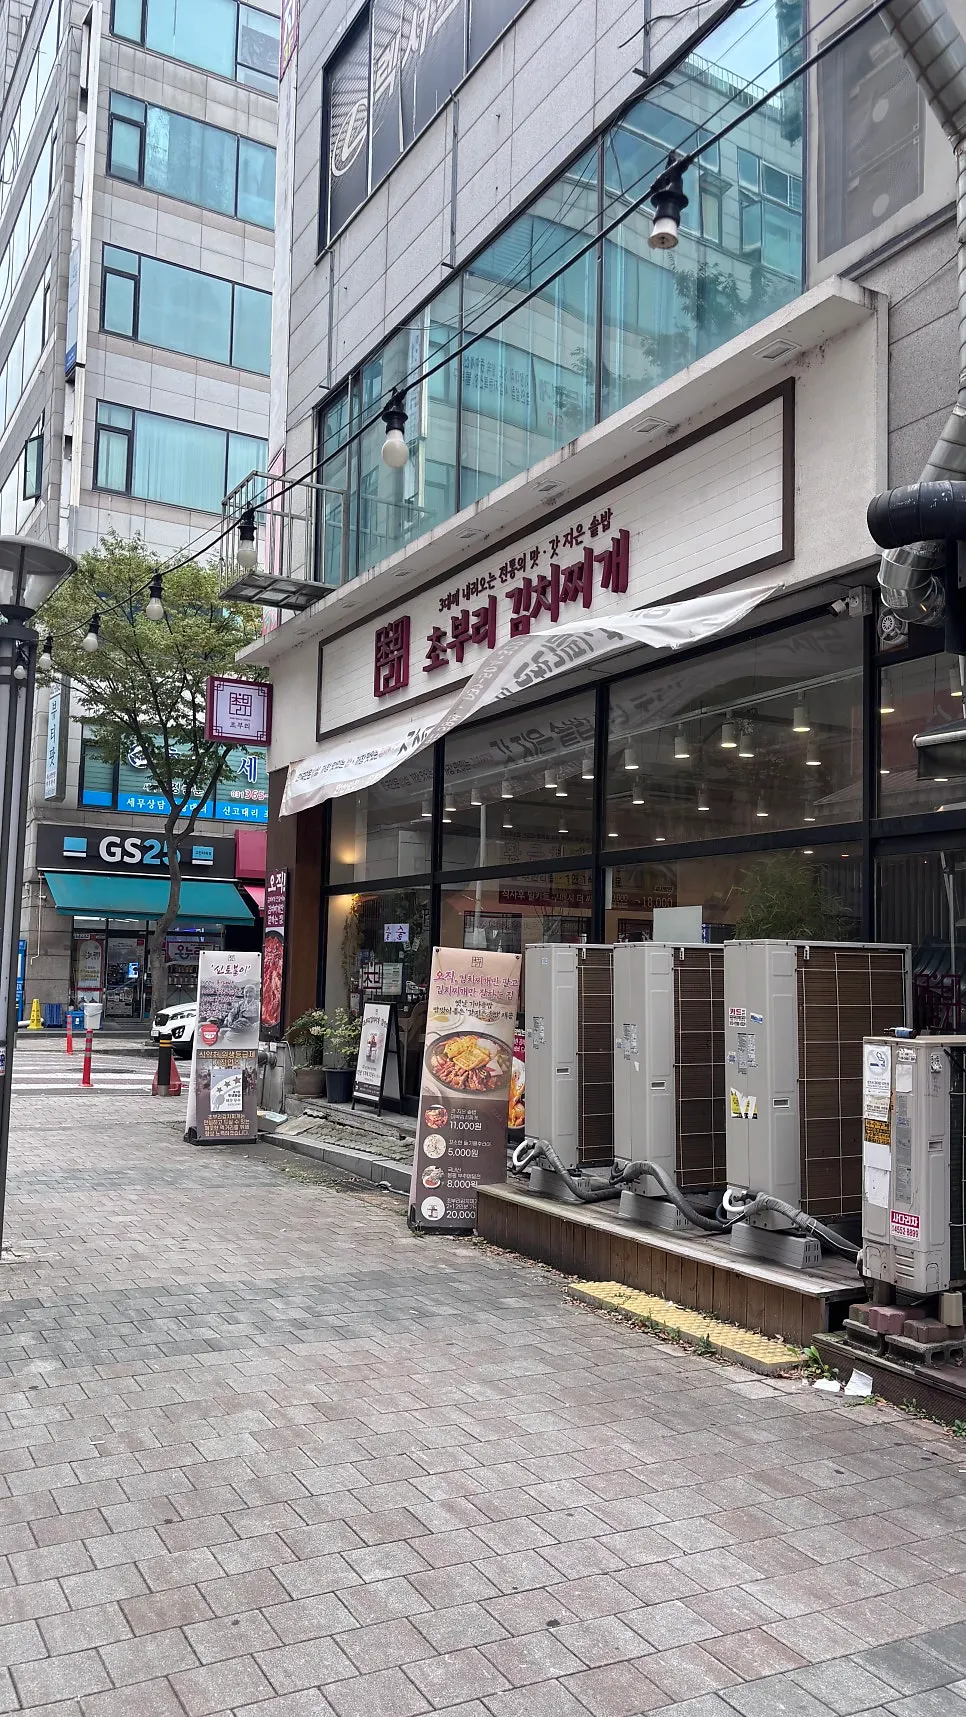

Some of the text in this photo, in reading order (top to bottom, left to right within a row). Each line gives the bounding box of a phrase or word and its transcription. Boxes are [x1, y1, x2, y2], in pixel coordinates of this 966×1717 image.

[461, 572, 498, 600] 내리오는
[499, 552, 527, 582] 전통의
[529, 549, 539, 568] 맛
[562, 523, 586, 548] 지은
[423, 594, 498, 674] 초부리
[505, 528, 630, 636] 김치찌개
[126, 798, 166, 811] 세무상담
[222, 805, 259, 818] 신고대리
[98, 835, 182, 866] GS25
[459, 974, 499, 987] 김치찌개만
[436, 985, 477, 998] 김치찌개만
[506, 990, 514, 1001] 집
[450, 1121, 482, 1131] 11,000원
[447, 1147, 479, 1158] 5,000원
